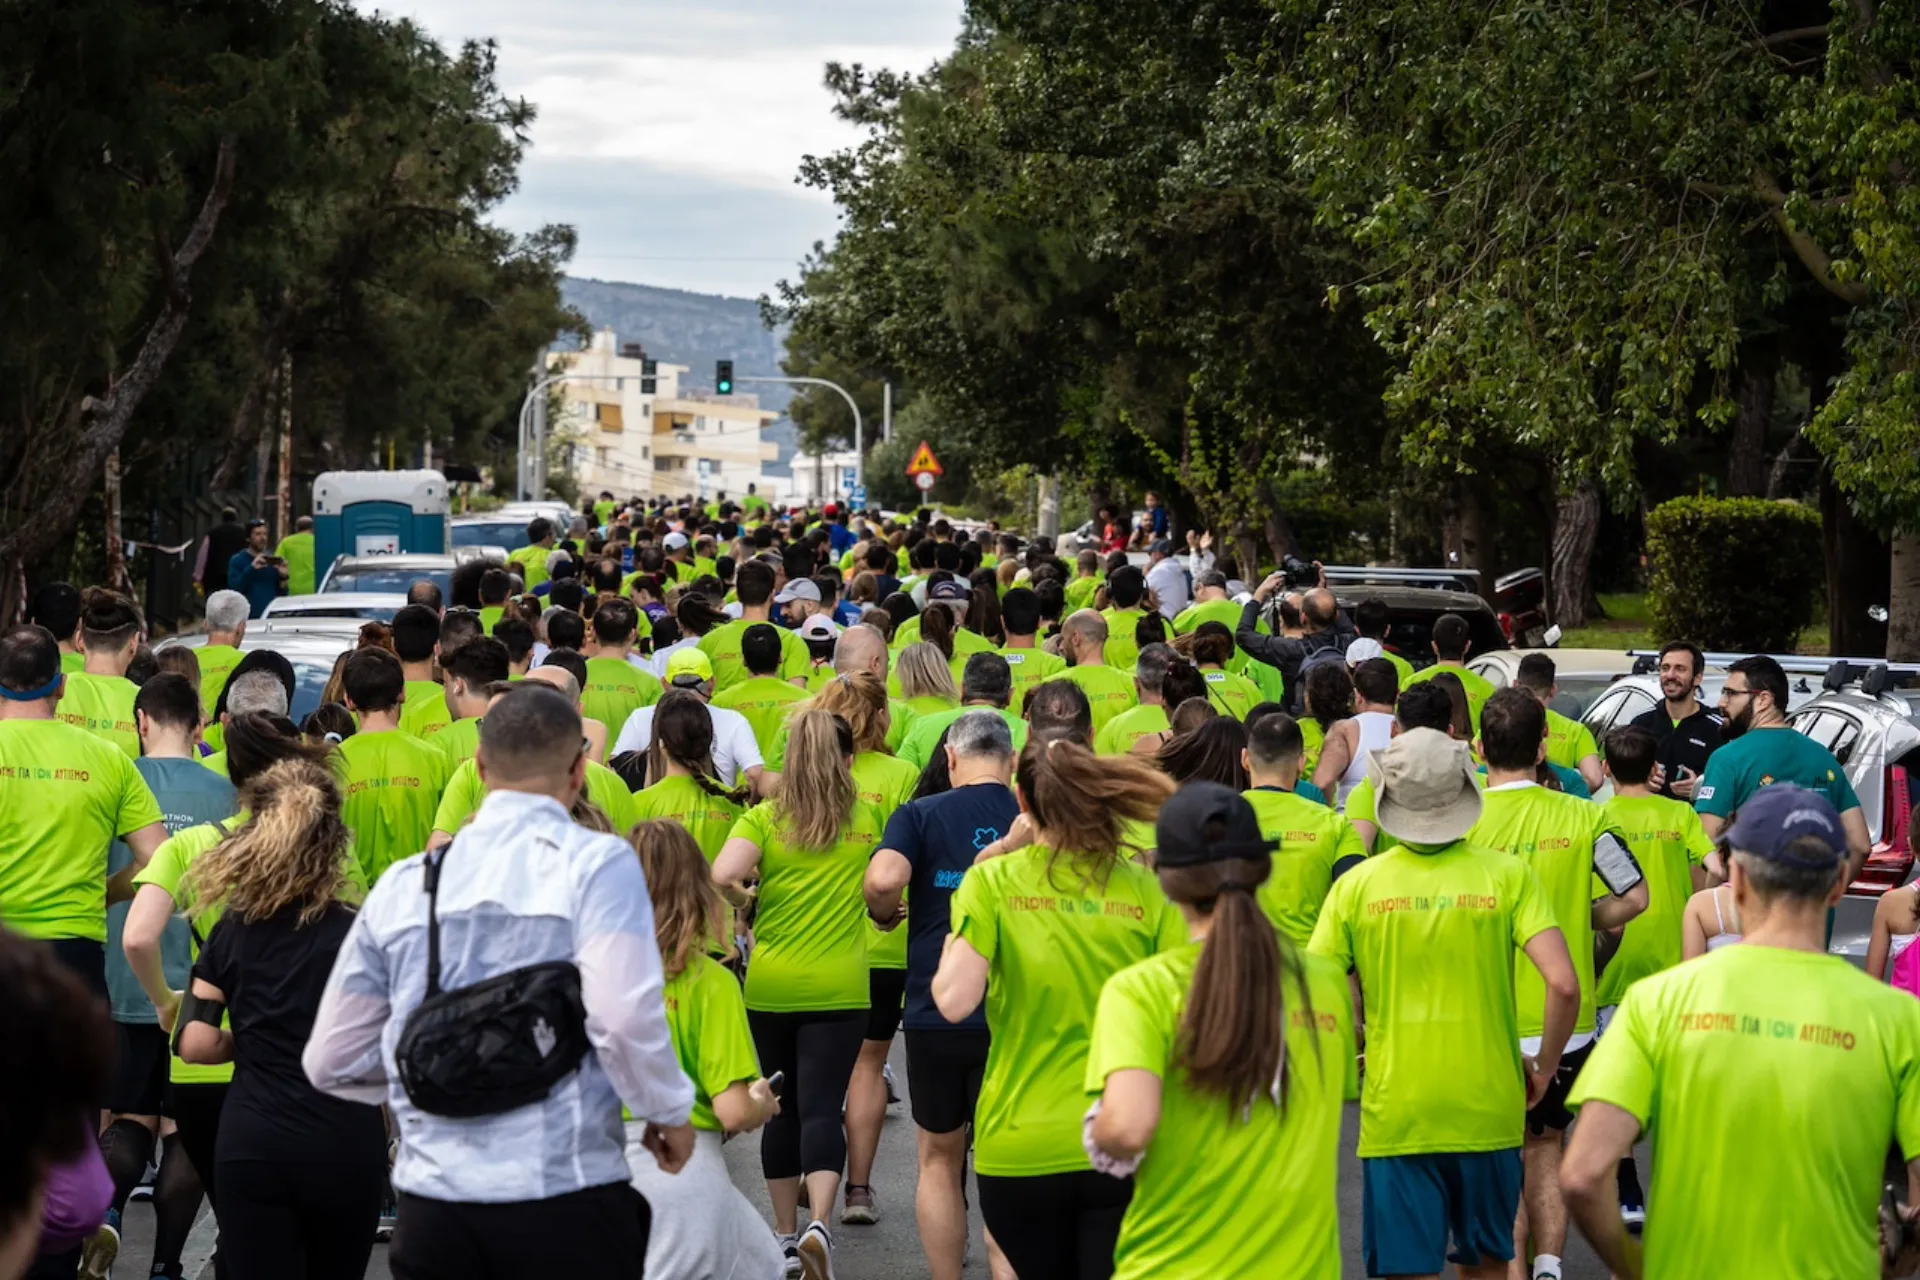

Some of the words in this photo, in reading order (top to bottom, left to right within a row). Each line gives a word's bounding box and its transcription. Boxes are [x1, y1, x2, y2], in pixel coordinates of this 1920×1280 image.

[19, 767, 31, 780] ΓΙΑ
[55, 768, 90, 782] ΑΥΤΙΣΜΟ
[1538, 837, 1570, 851] ΑΥΤΙΣΜΟ
[1009, 896, 1056, 912] ΤΡΕΧΟΥΜΕ
[1060, 897, 1074, 912] ΓΙΑ
[1103, 901, 1144, 921] ΑΥΤΙΣΜΟ
[1367, 895, 1412, 916] ΤΡΕΧΟΥΜΕ
[1415, 896, 1429, 911] ΓΙΑ
[1432, 895, 1453, 911] ΤΟΝ
[1456, 894, 1497, 909] ΑΥΤΙΣΜΟ
[1679, 1013, 1736, 1032] ΤΡΕΧΟΥΜΕ
[1741, 1014, 1760, 1036] ΓΙΑ
[1766, 1018, 1796, 1040] ΤΟΝ
[1800, 1024, 1856, 1051] ΑΥΤΙΣΜΟ
